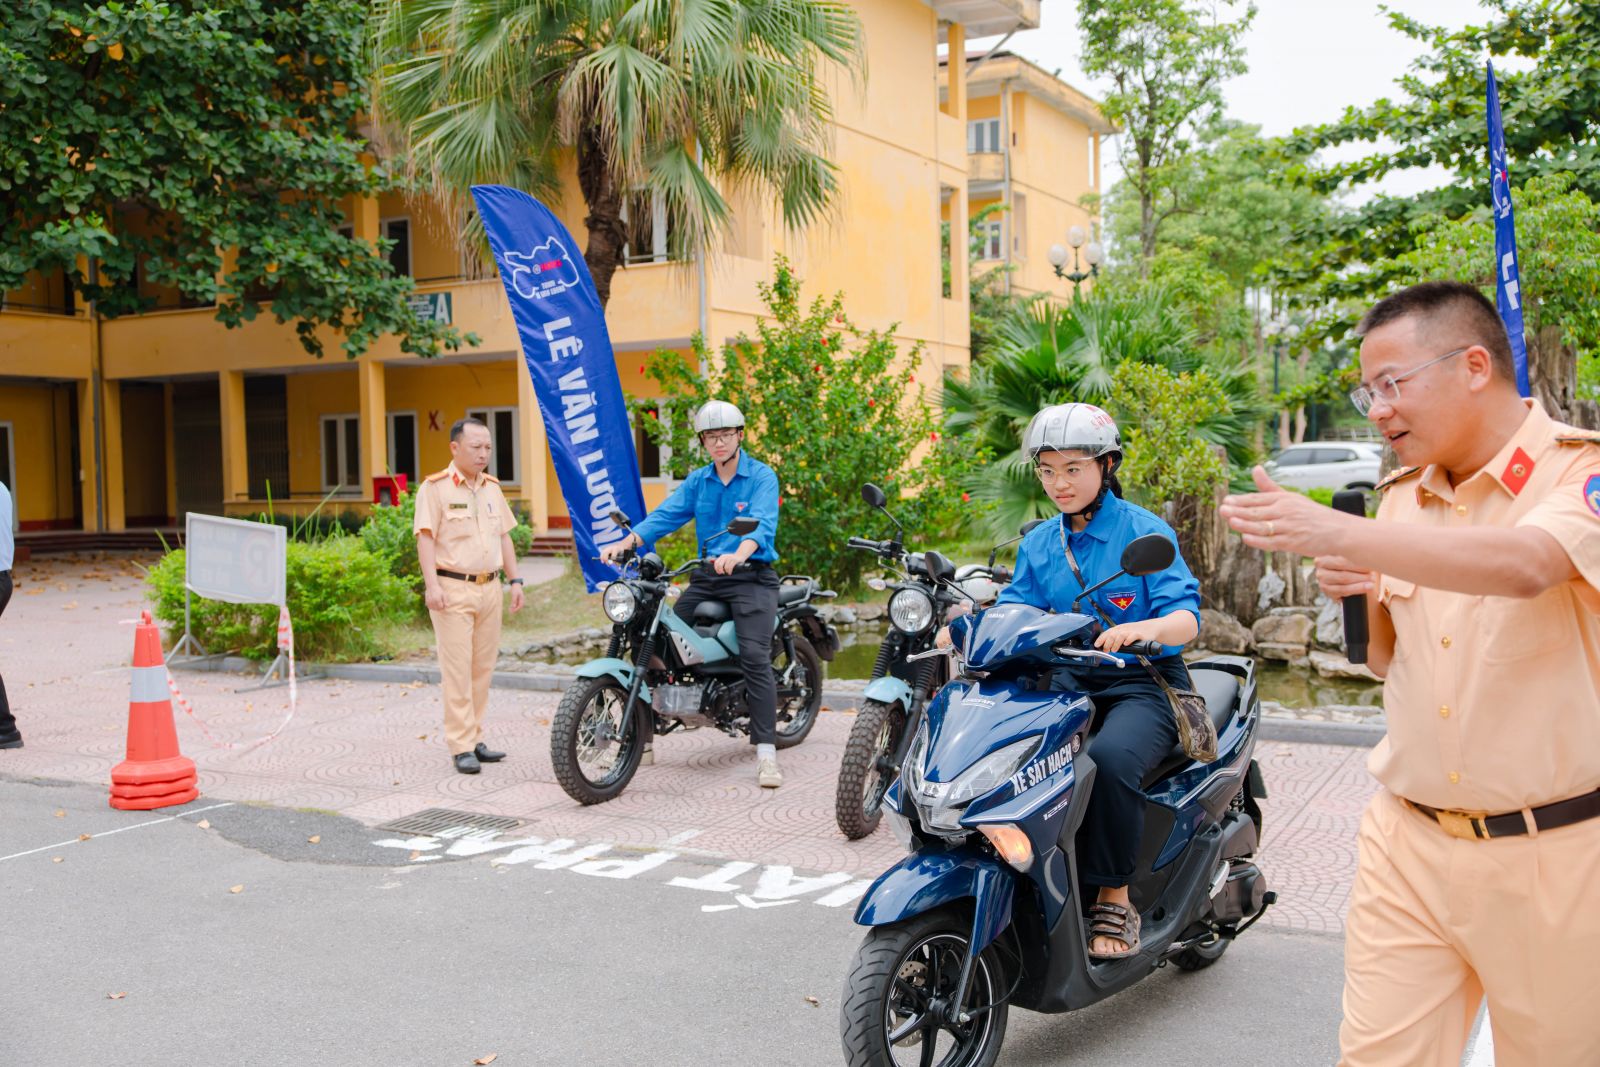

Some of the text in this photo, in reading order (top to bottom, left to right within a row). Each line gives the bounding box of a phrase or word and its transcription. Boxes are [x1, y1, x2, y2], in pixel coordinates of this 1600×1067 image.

[435, 293, 450, 325] A
[543, 316, 584, 363] LÊ
[557, 366, 599, 445] VĂN
[577, 449, 625, 551] LƯƠN
[1009, 742, 1073, 797] XE SÁT HẠCH
[1042, 798, 1068, 821] 125
